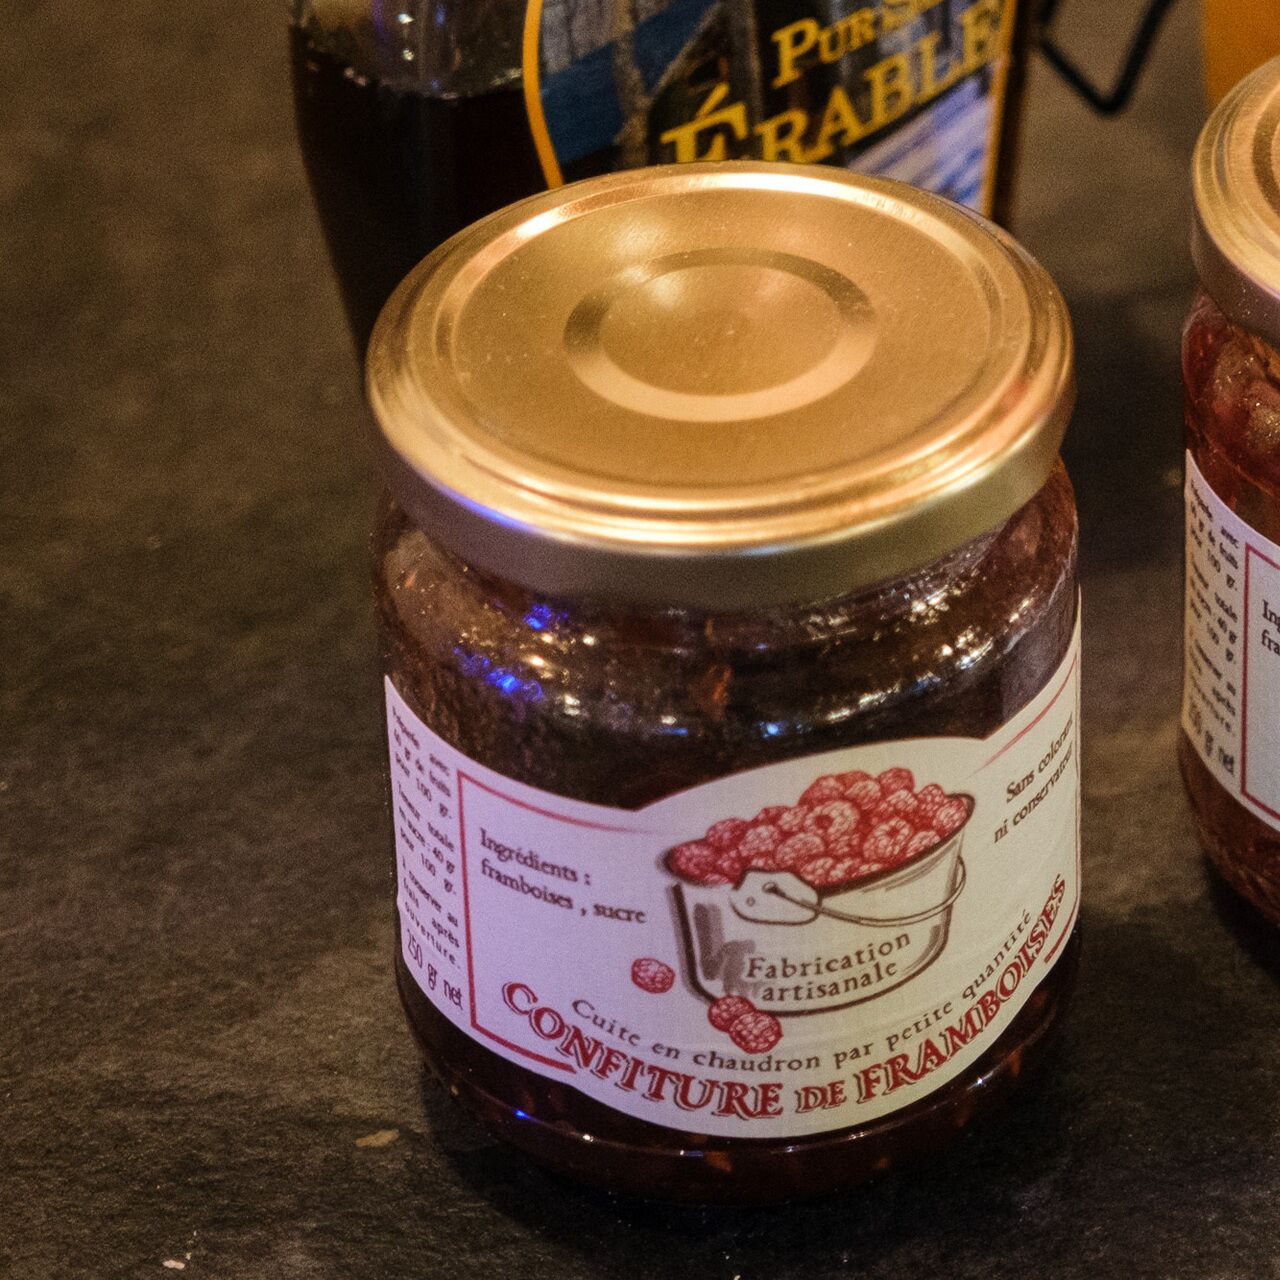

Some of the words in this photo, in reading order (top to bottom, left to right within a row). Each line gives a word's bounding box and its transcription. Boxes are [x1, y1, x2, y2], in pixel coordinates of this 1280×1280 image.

[1006, 770, 1035, 803] Sans
[480, 827, 578, 882] Ingrédients
[994, 819, 1008, 843] ni
[481, 858, 573, 909] framboises
[593, 903, 647, 923] sucre
[746, 933, 911, 979] Fabrication
[762, 961, 897, 1001] artisanale
[502, 982, 785, 1120] CONFITURE
[795, 1080, 846, 1113] DE
[856, 874, 1067, 1105] FRAMBOISES
[571, 999, 641, 1046] Cuite
[652, 1042, 680, 1059] en
[693, 1050, 820, 1073] chaudron
[834, 1042, 874, 1069] par
[887, 1001, 953, 1051] petite
[962, 909, 1031, 1001] quantité
